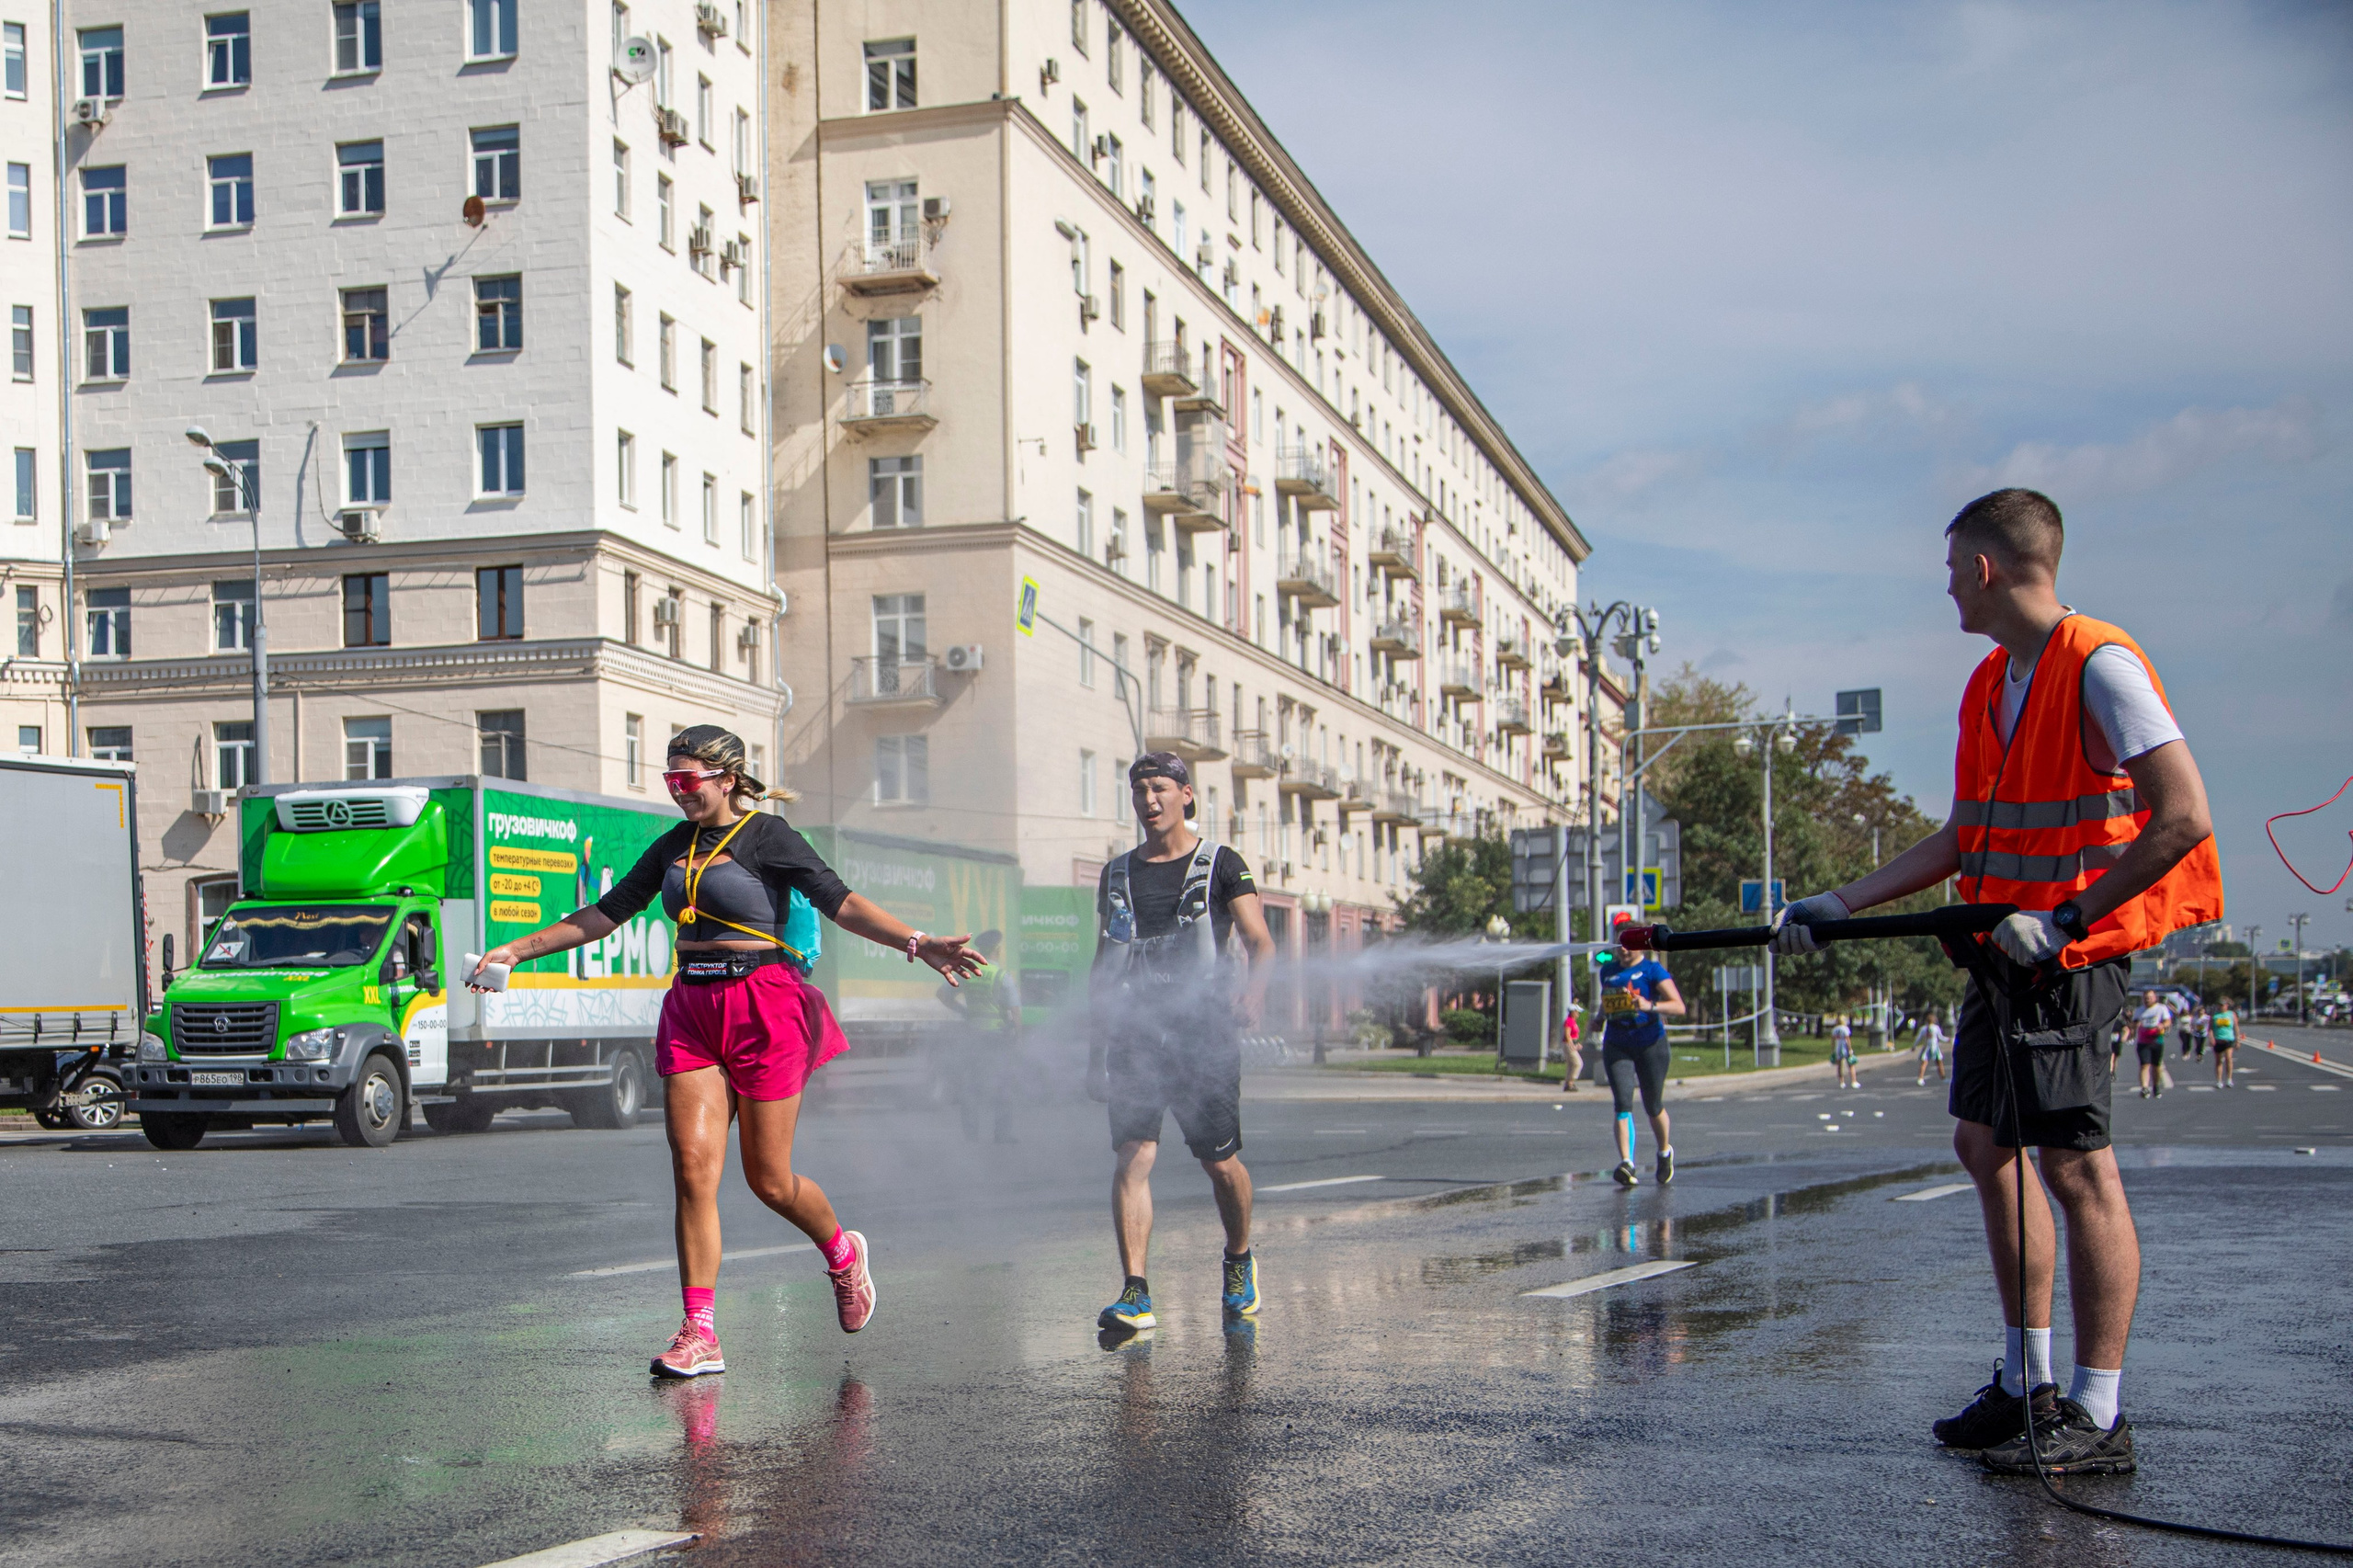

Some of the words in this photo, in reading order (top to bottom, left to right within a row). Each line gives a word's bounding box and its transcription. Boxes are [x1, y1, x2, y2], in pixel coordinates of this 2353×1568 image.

[488, 812, 577, 843] грузовичкоф
[493, 853, 542, 868] температурные
[543, 858, 574, 869] перевозки
[493, 881, 500, 890] от
[502, 879, 512, 890] -20
[514, 882, 523, 892] до
[523, 881, 531, 891] +4
[499, 905, 519, 917] любой
[520, 909, 539, 918] сезон
[363, 985, 381, 1005] XXL
[417, 1019, 447, 1029] 150-00-00
[193, 1074, 228, 1084] Р865ЕО
[229, 1073, 243, 1082] 198
